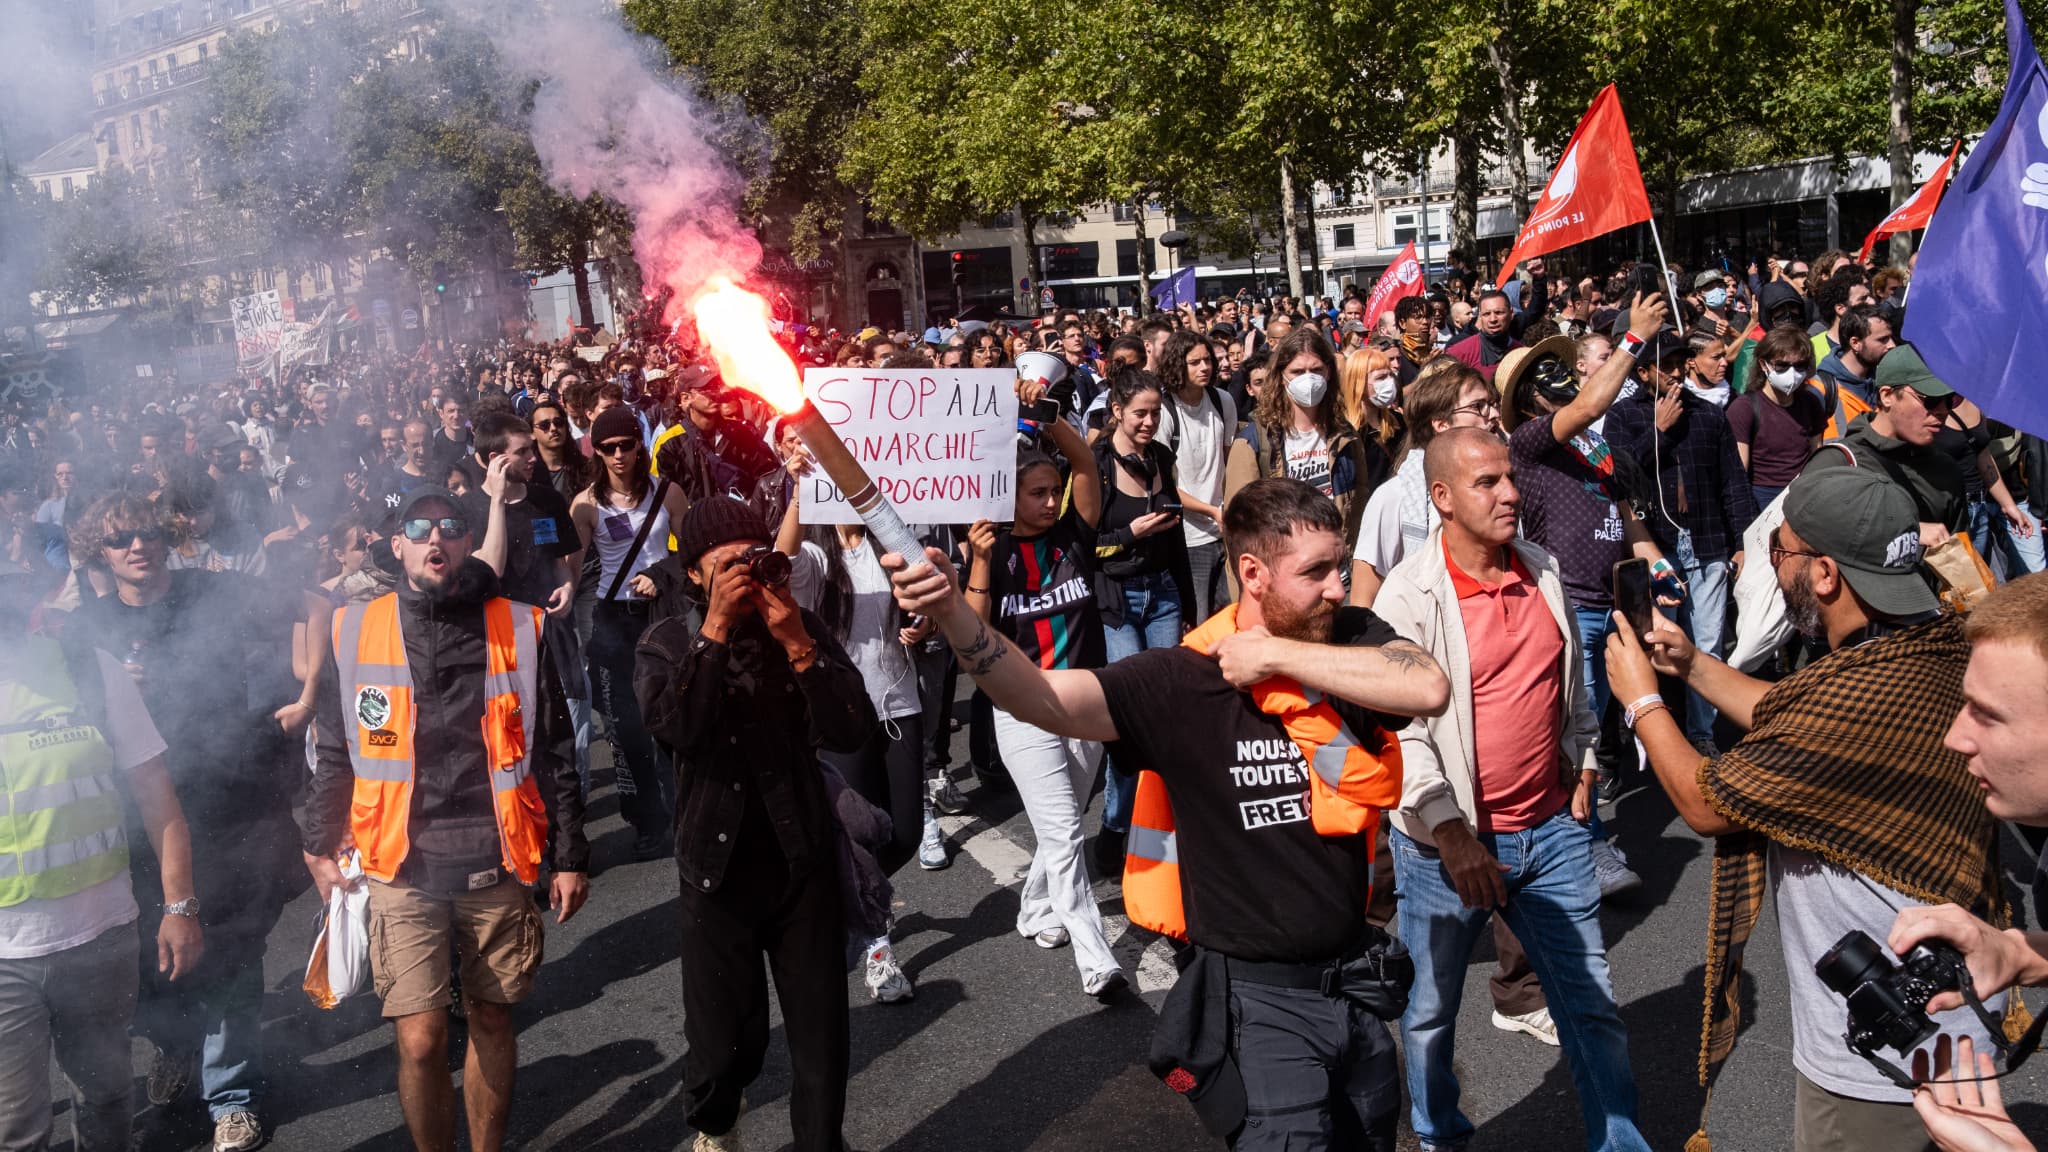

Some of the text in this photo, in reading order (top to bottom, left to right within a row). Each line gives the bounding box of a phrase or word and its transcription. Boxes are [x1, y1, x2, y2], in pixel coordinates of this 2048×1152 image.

[96, 71, 174, 105] HOTEL
[818, 377, 1000, 425] STOP À LA
[842, 429, 986, 466] ONARCHIE
[877, 473, 981, 504] POGNON
[1001, 576, 1090, 617] PALESTINE
[369, 734, 397, 745] SNCF
